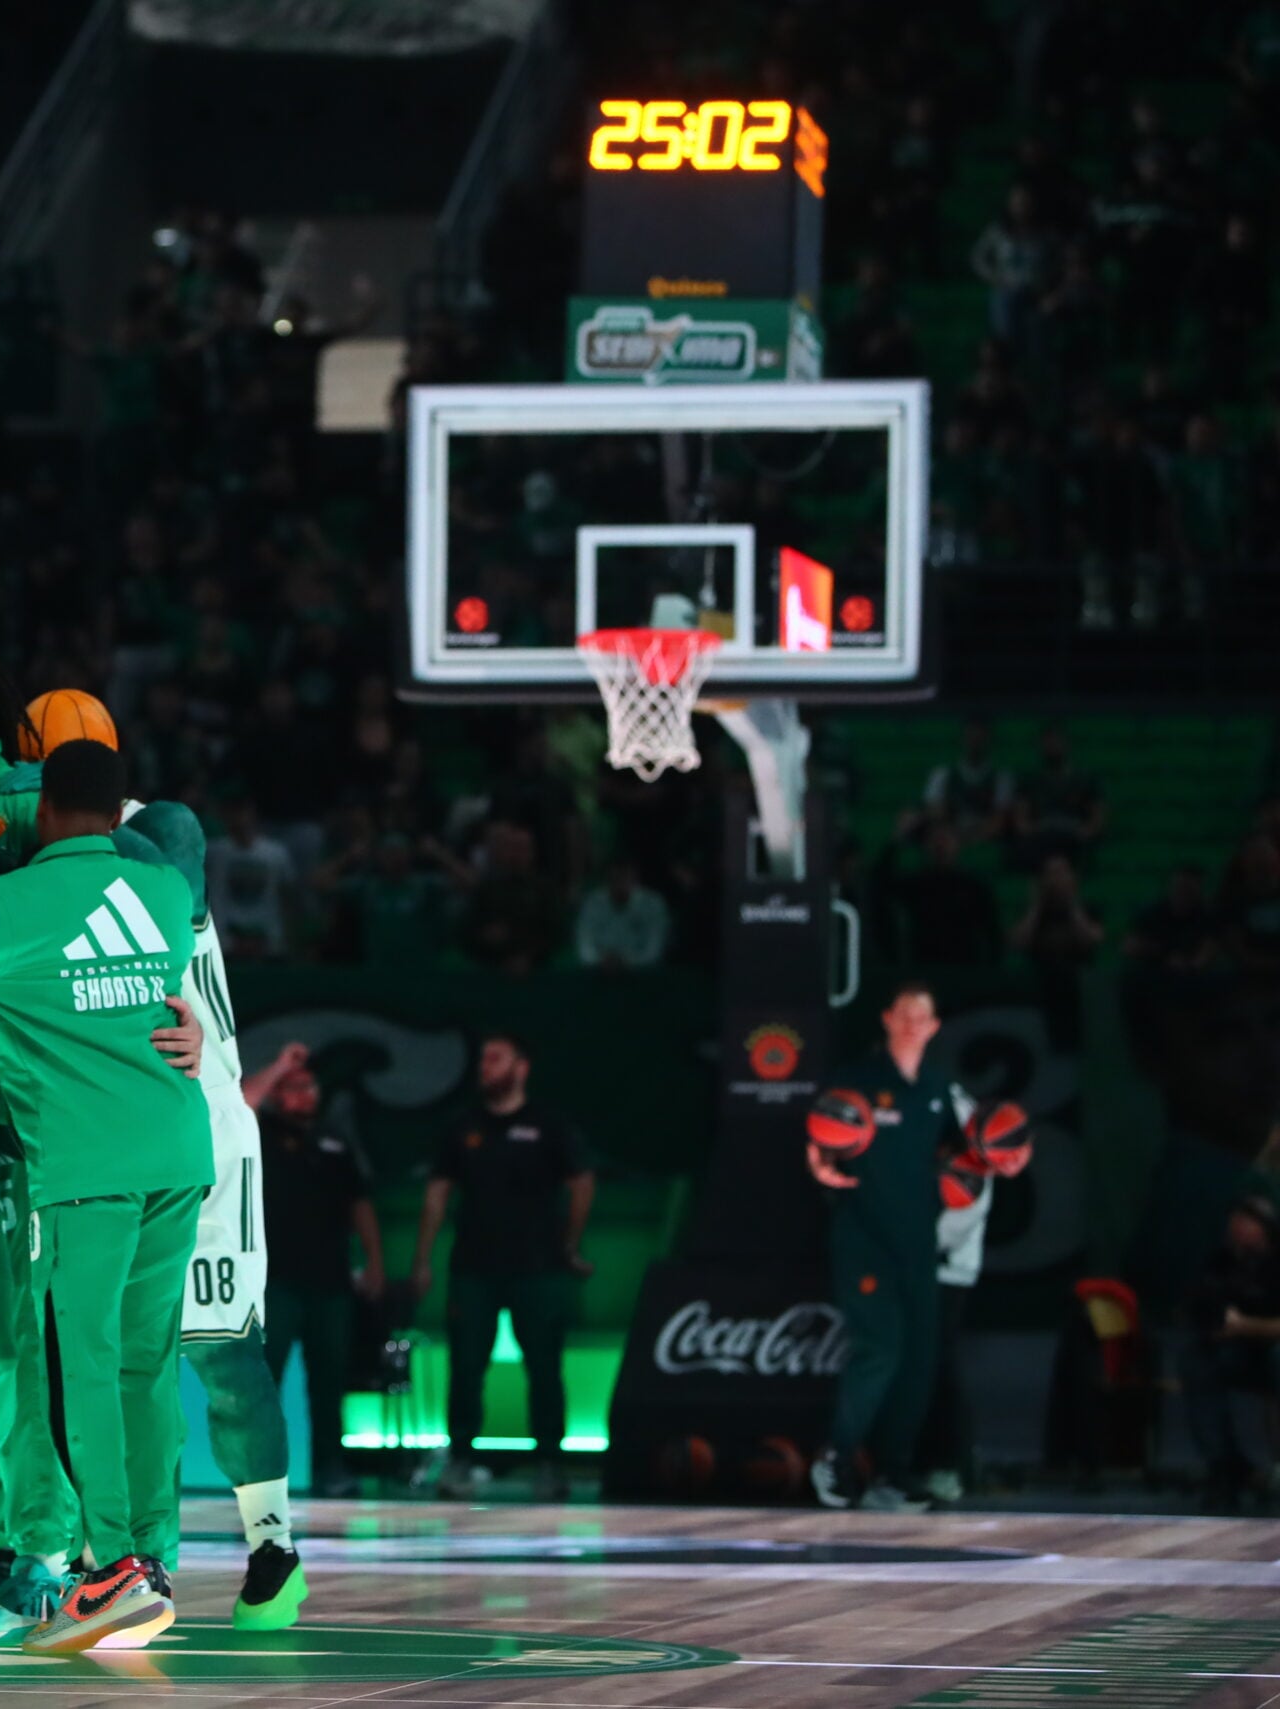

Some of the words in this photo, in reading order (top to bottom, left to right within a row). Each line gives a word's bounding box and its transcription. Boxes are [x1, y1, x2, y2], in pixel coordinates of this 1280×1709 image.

[589, 100, 791, 171] 25:02
[72, 975, 150, 1012] SHORTS
[192, 1256, 235, 1306] 08
